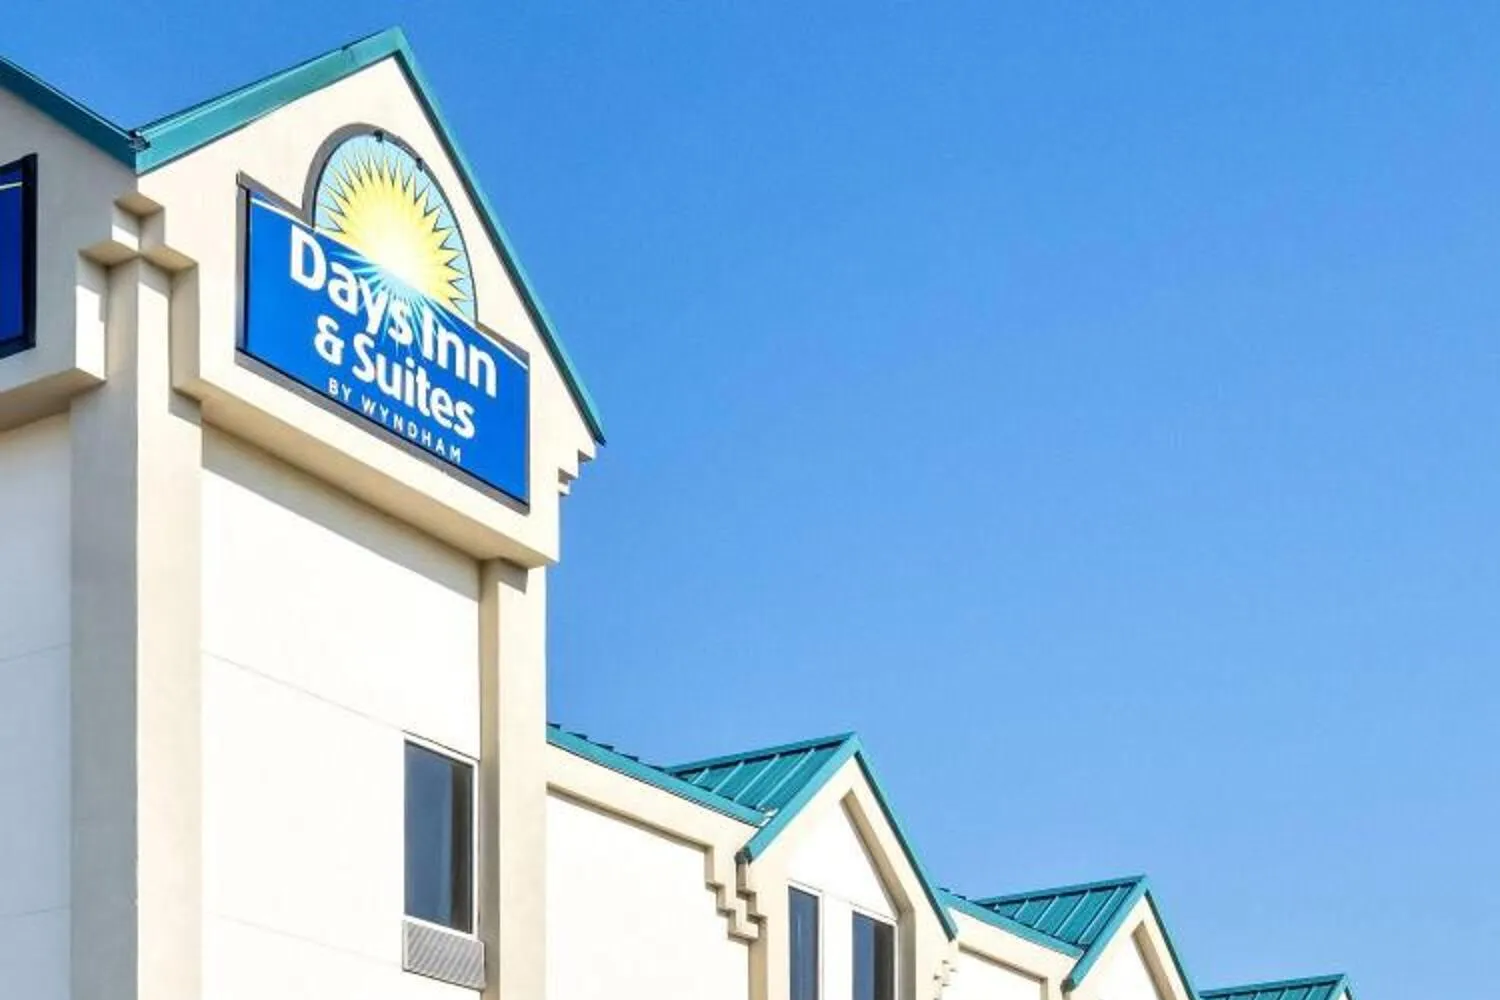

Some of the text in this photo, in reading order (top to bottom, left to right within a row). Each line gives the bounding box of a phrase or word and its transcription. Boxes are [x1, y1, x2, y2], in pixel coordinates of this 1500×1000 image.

[291, 223, 496, 398] Days Inn
[314, 315, 475, 439] & Suites
[328, 377, 461, 463] BY WYNDHAM
